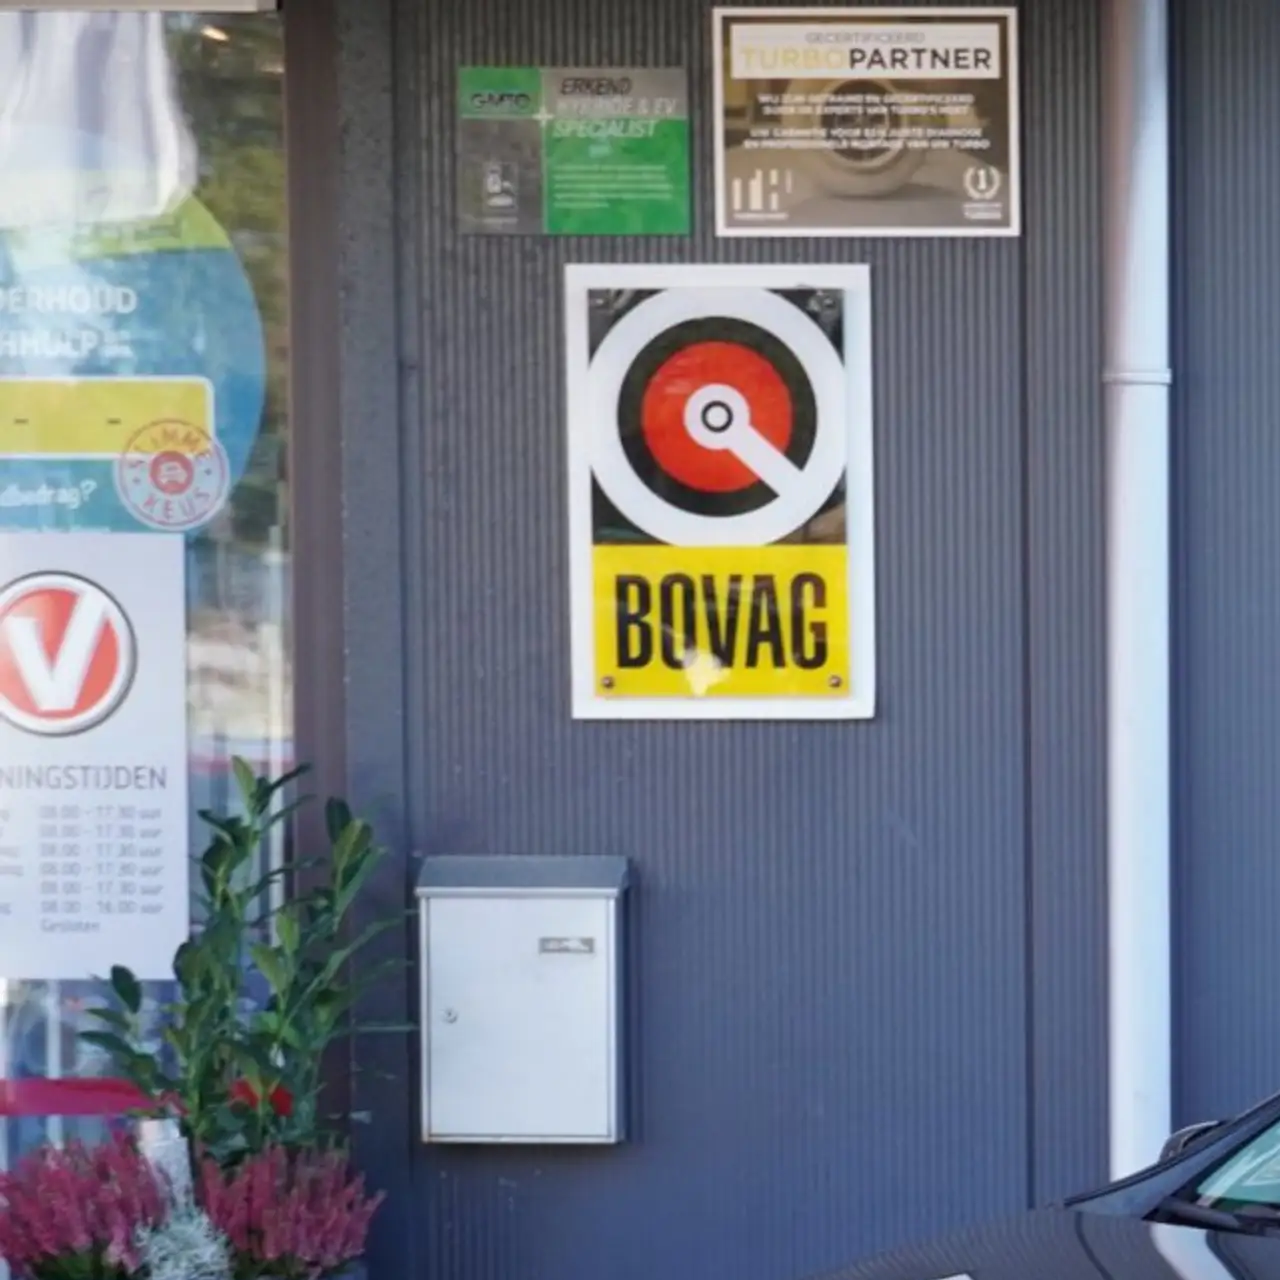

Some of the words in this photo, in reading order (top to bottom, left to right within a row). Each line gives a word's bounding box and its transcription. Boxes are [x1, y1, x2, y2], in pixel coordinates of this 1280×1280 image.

[560, 76, 633, 96] ERKEND
[552, 119, 659, 138] SPECIALIST
[0, 285, 138, 314] ERHOUD
[614, 571, 829, 672] BOVAG
